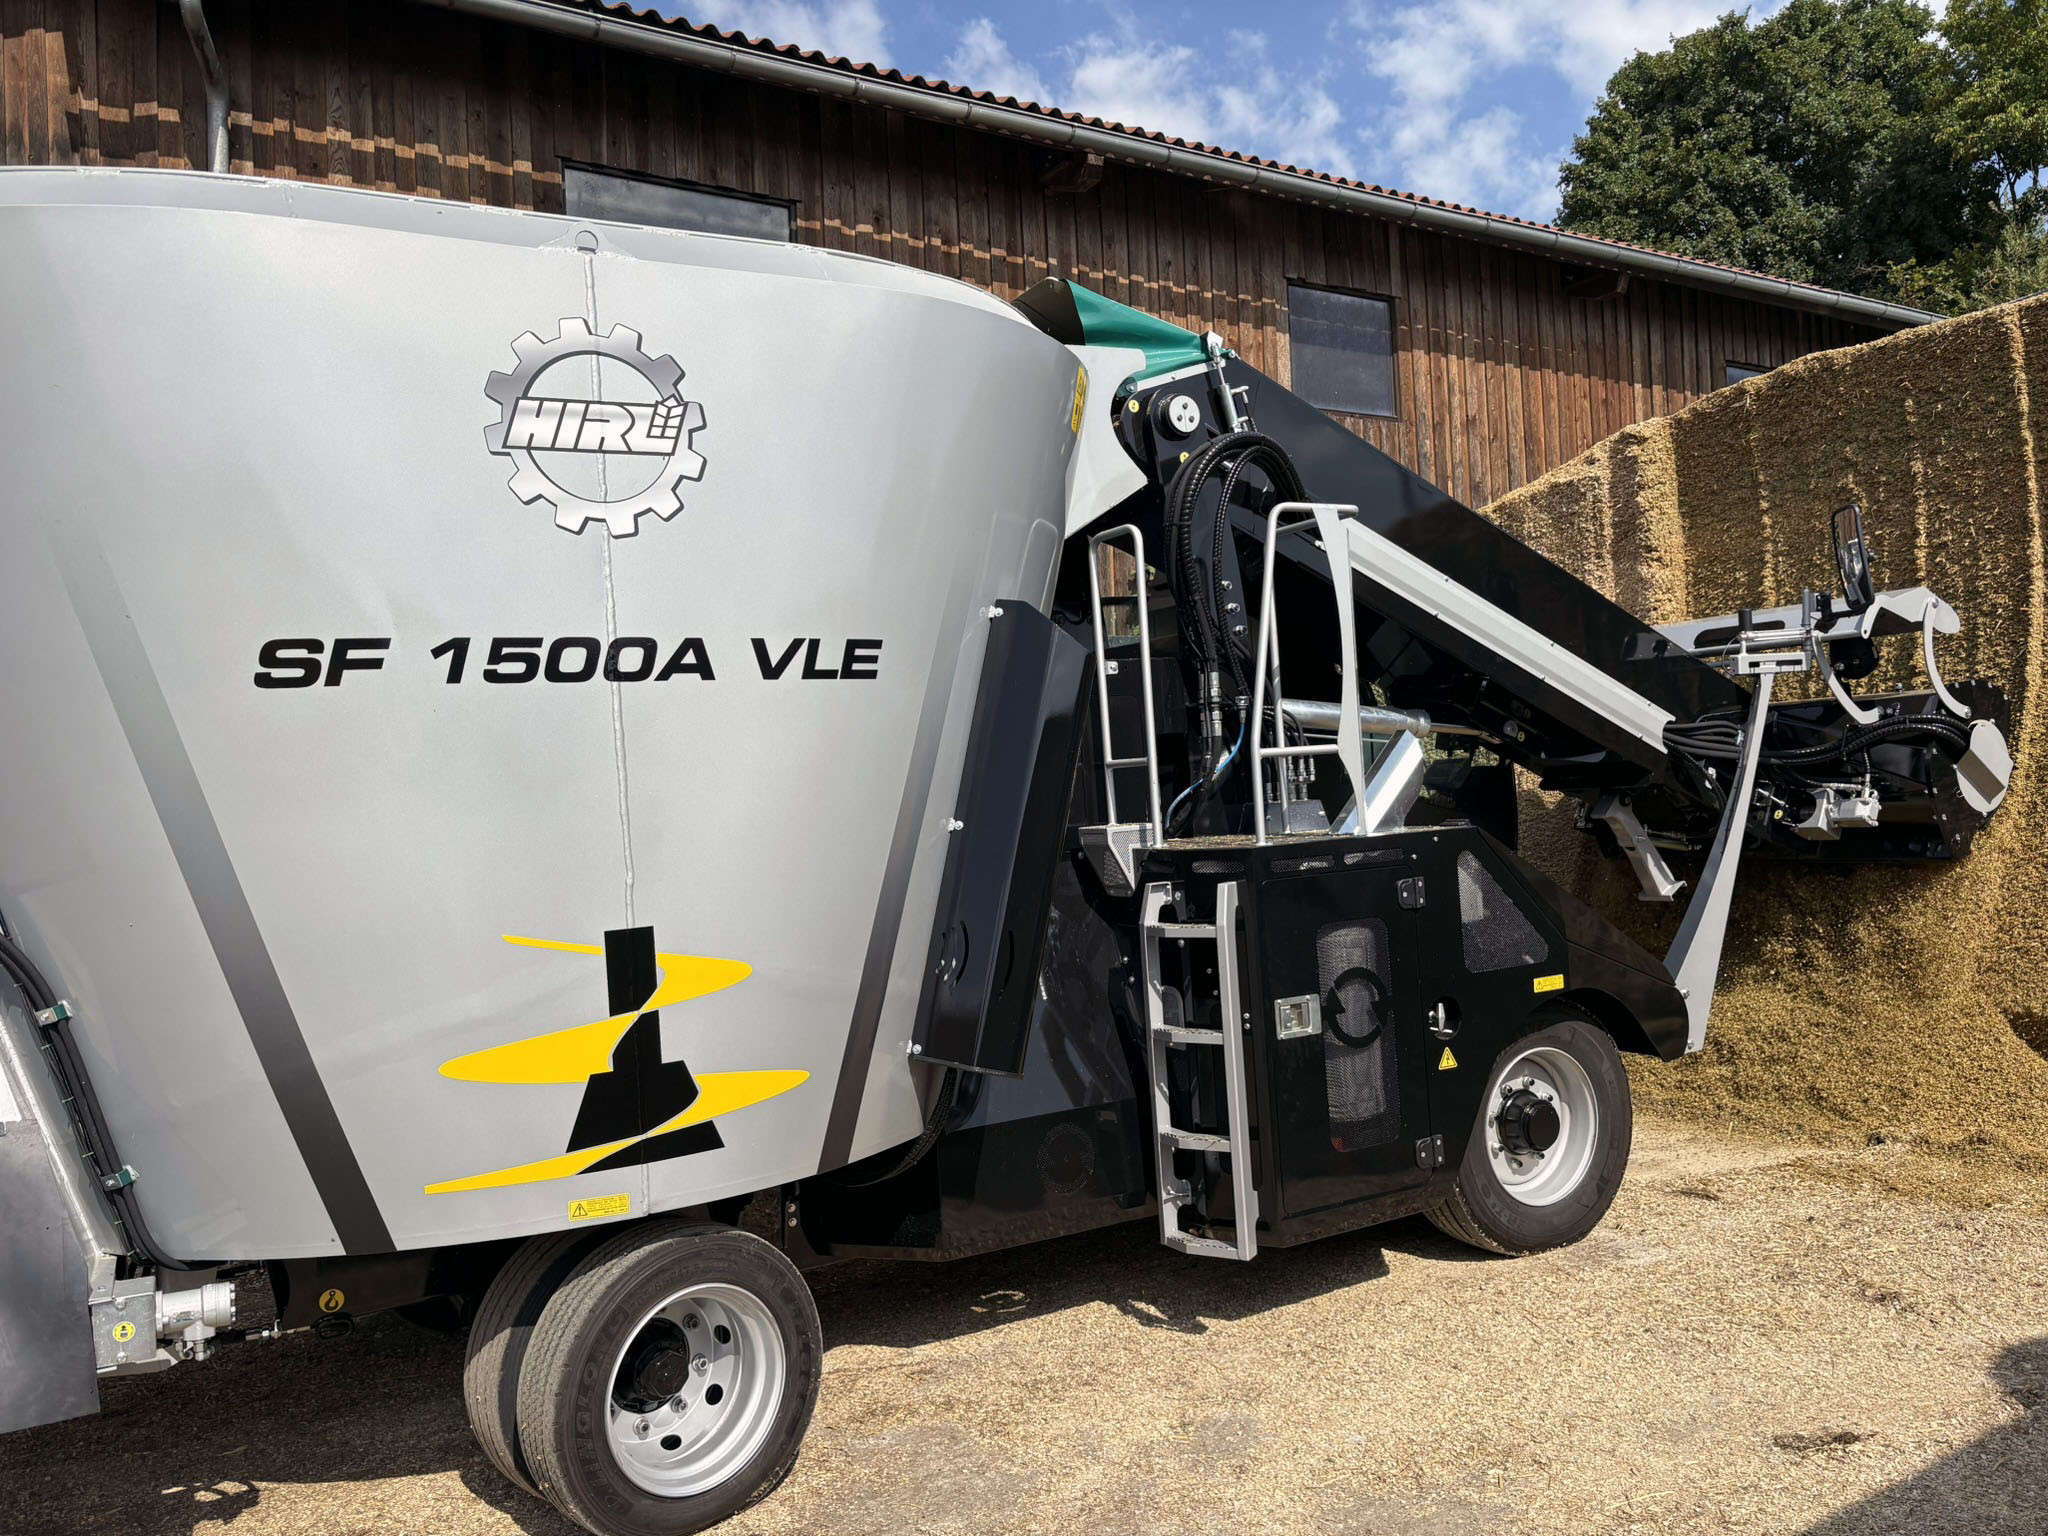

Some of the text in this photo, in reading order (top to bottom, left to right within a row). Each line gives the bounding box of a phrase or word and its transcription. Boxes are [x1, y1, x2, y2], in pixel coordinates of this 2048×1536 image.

[254, 637, 883, 689] SF 1500A VLE
